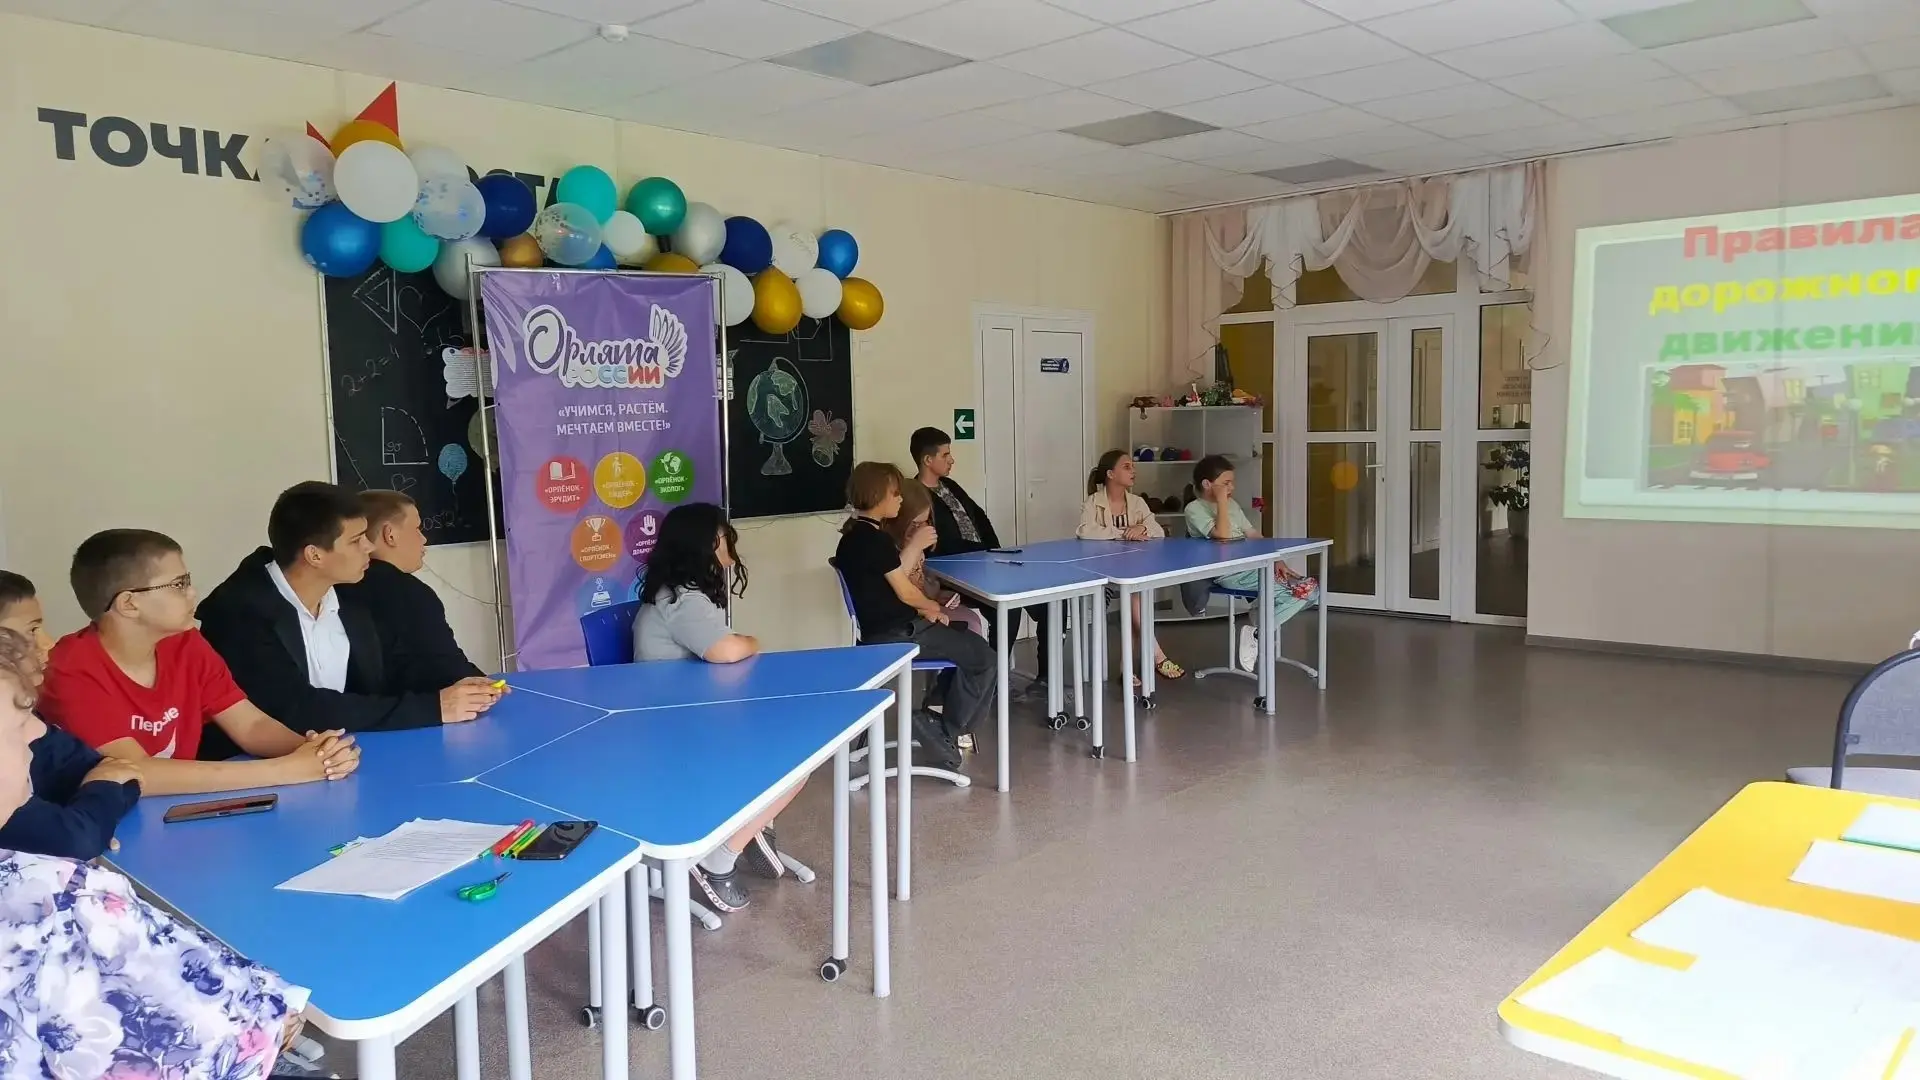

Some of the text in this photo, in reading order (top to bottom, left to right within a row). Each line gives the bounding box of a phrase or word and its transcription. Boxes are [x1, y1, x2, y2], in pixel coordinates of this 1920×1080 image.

[37, 107, 260, 182] ТОЧК
[1683, 214, 1920, 263] Правила
[526, 308, 661, 376] Орлята
[1658, 321, 1920, 362] движени
[556, 419, 671, 436] МЕЧТАЕМ ВМЕСТЕ!»
[558, 403, 616, 418] «УЧИМСЯ,
